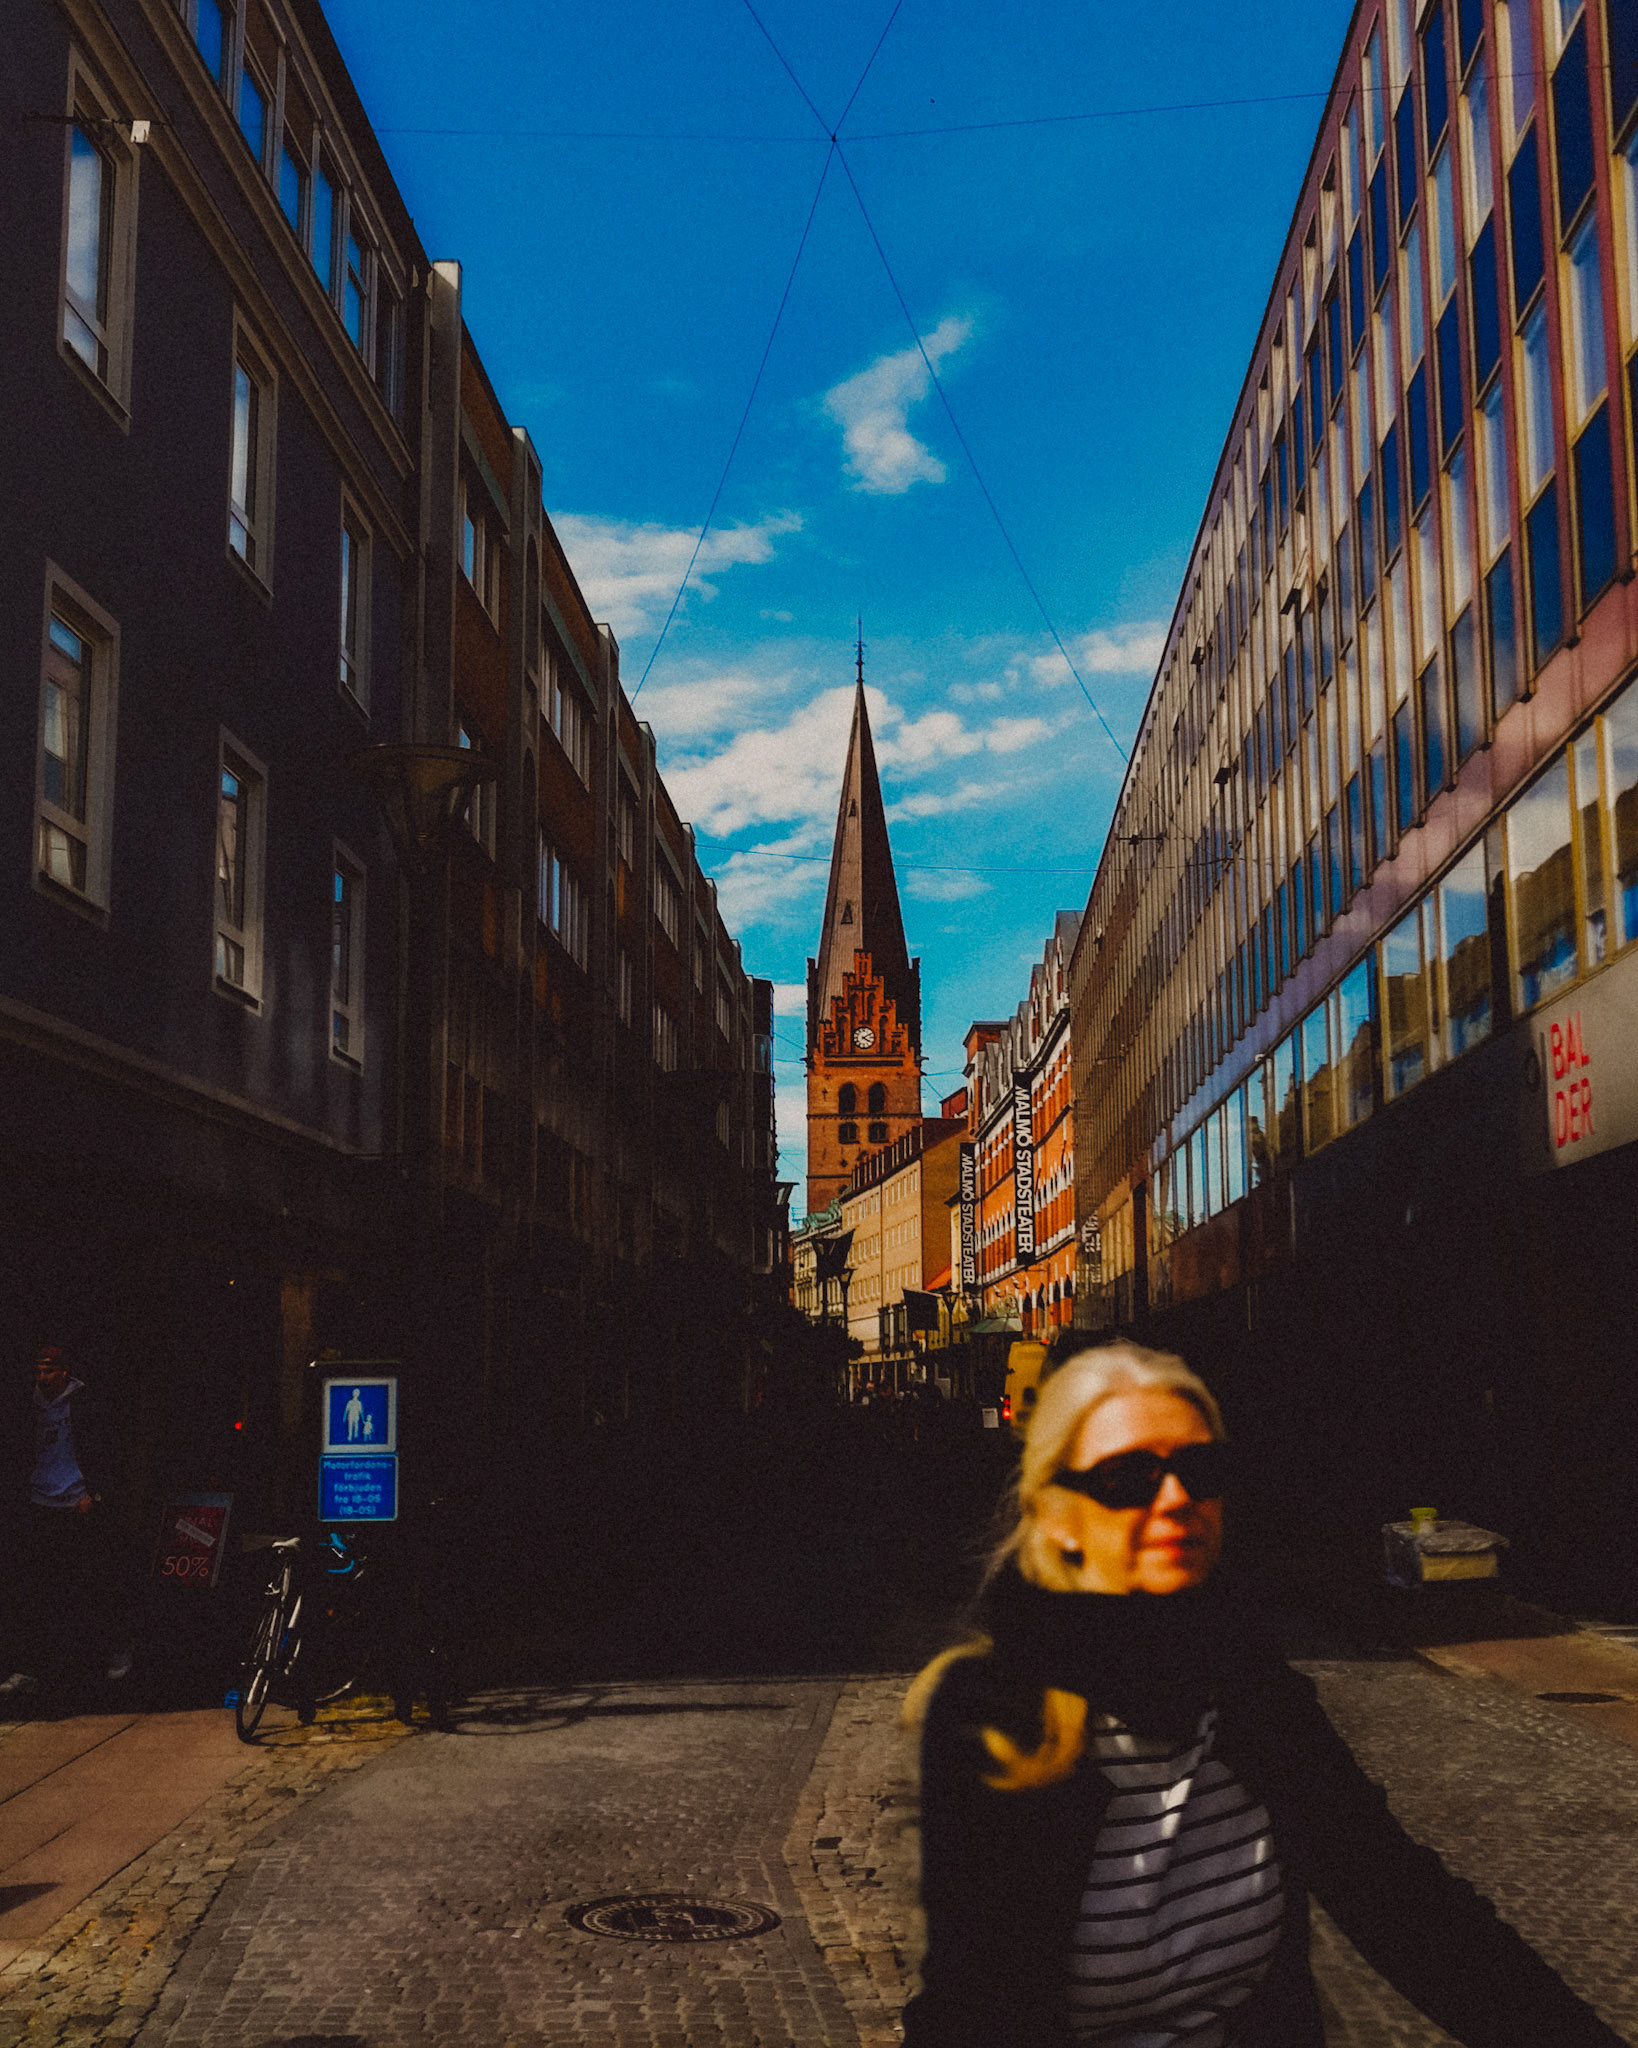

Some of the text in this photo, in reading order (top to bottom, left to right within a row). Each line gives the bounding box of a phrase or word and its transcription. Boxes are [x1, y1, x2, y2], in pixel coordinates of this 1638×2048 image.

[1551, 1010, 1590, 1080] BAL
[1555, 1077, 1595, 1148] DER
[1015, 1085, 1034, 1254] MALMÖ STADSTEATER
[961, 1152, 976, 1285] MALMÖ STADSTEATER
[160, 1555, 209, 1577] 50%
